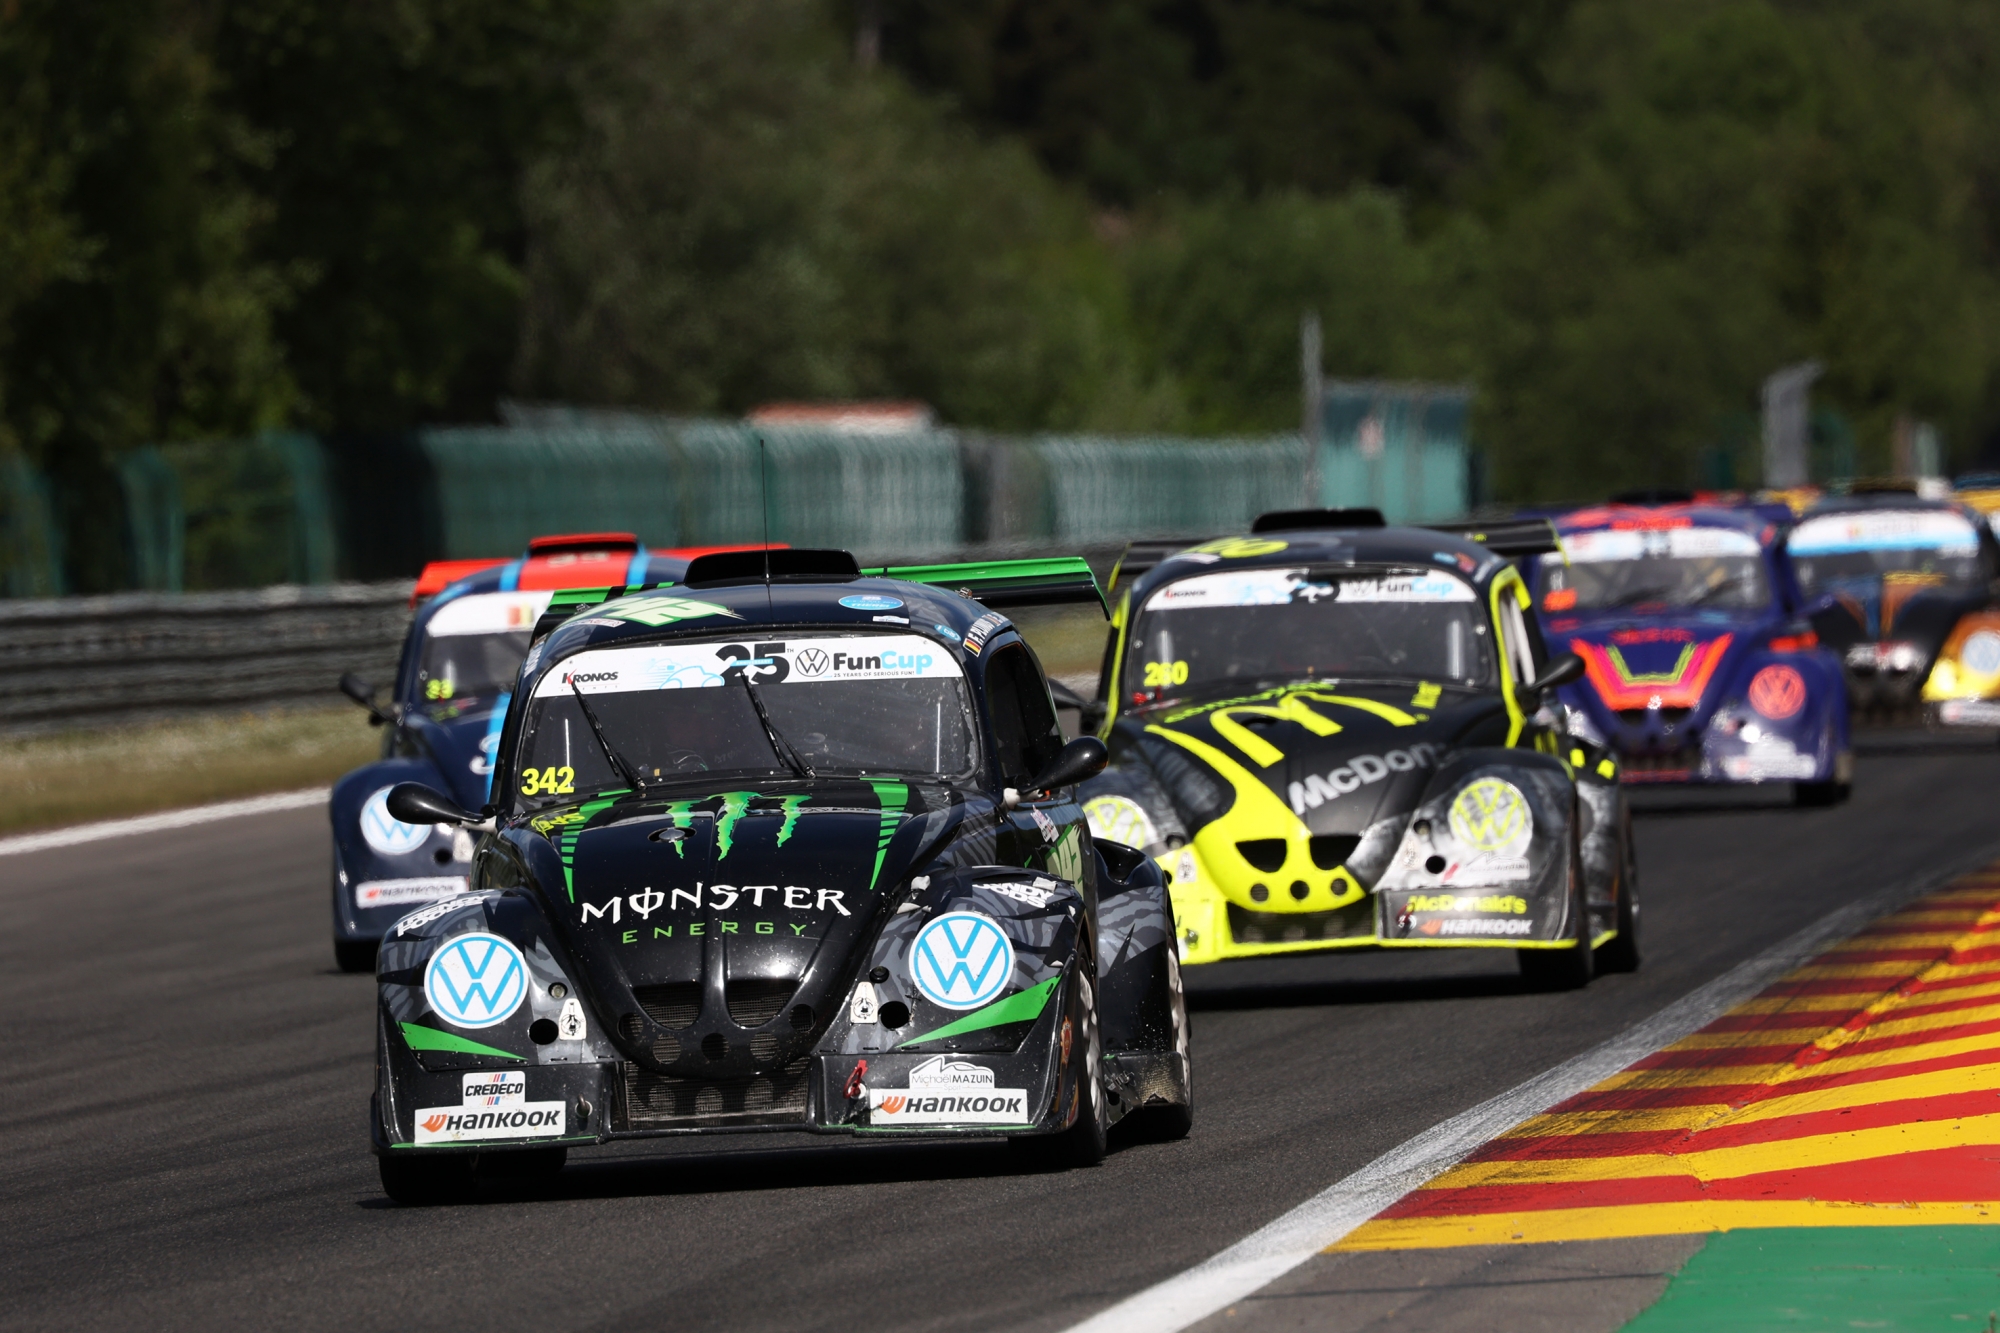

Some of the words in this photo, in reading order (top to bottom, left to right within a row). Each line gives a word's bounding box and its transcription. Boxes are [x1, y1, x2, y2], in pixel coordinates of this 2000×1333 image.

[715, 642, 790, 686] 25
[833, 650, 932, 674] FunCup
[561, 668, 618, 684] KRONOS
[521, 766, 575, 796] 342
[581, 882, 851, 924] MONSTER
[622, 921, 807, 944] ENERGY
[465, 1083, 524, 1097] CREDECO
[952, 1074, 993, 1084] MAZUIN
